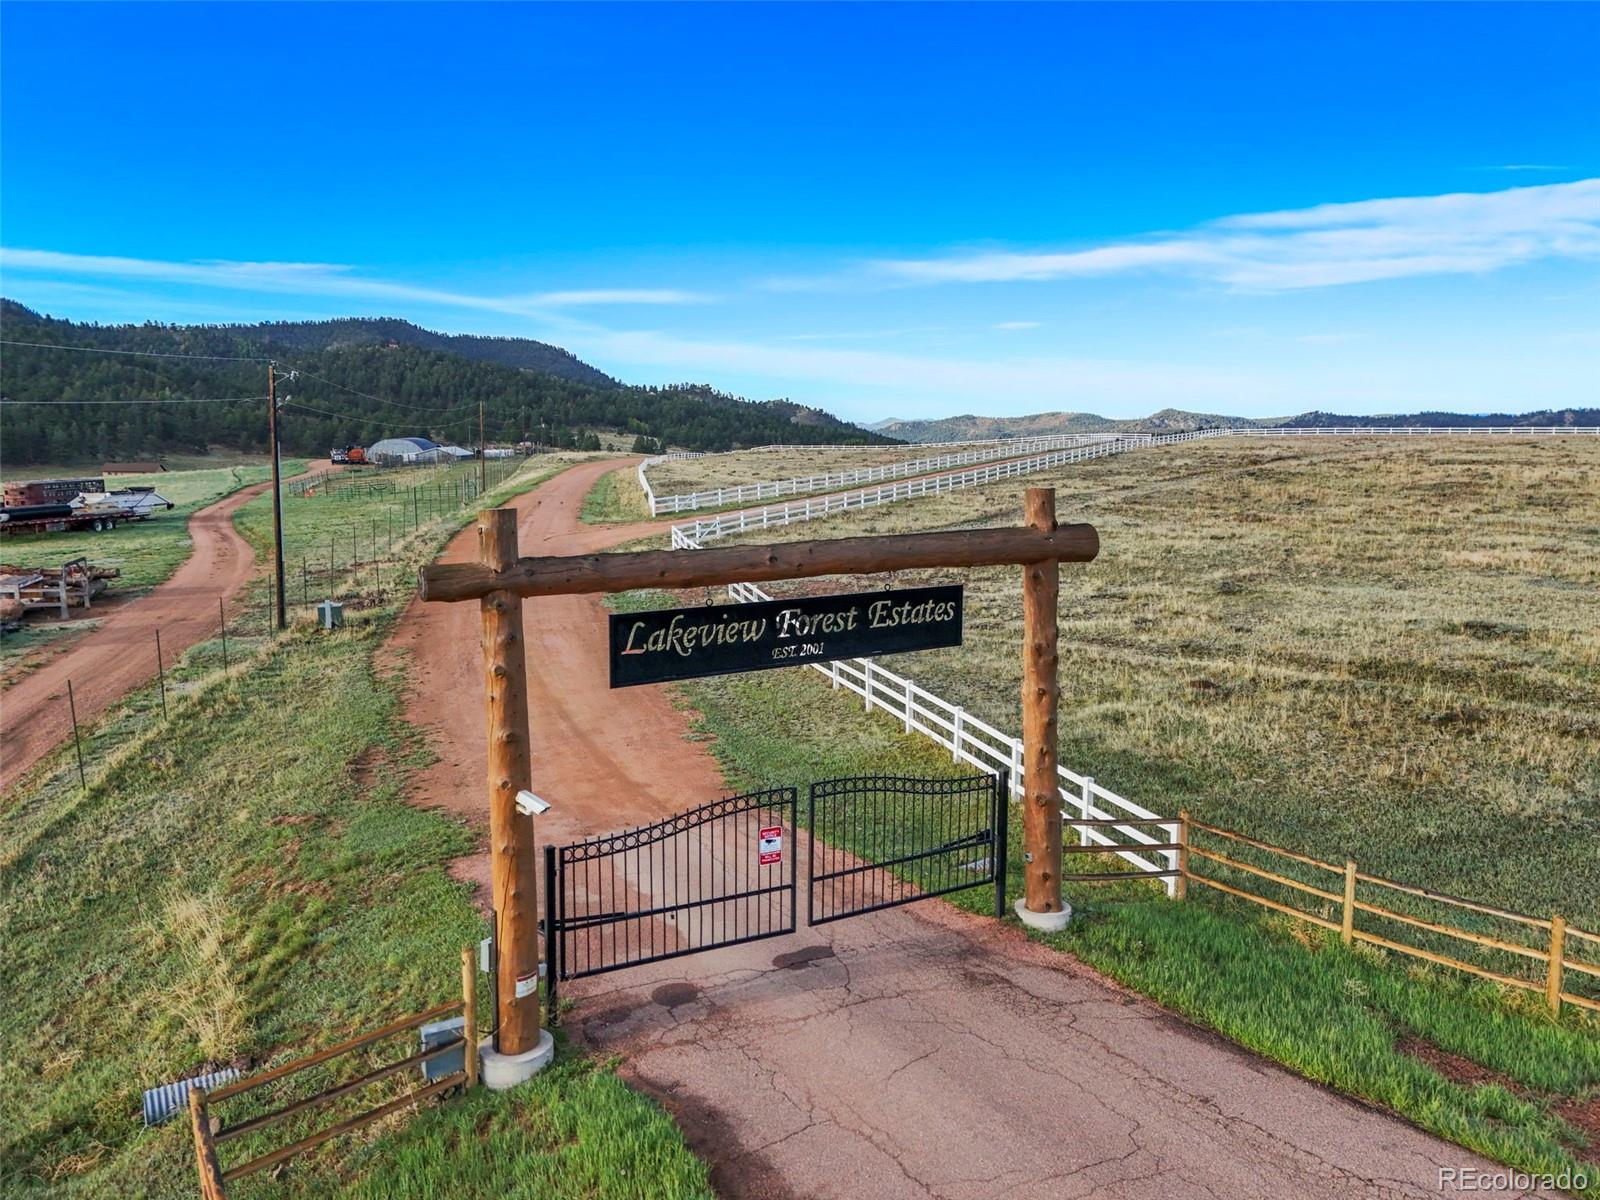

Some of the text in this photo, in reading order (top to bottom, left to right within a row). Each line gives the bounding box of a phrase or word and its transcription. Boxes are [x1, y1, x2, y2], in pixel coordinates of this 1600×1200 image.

[621, 598, 956, 657] Lakeview Forest Estates
[799, 642, 825, 657] 2001
